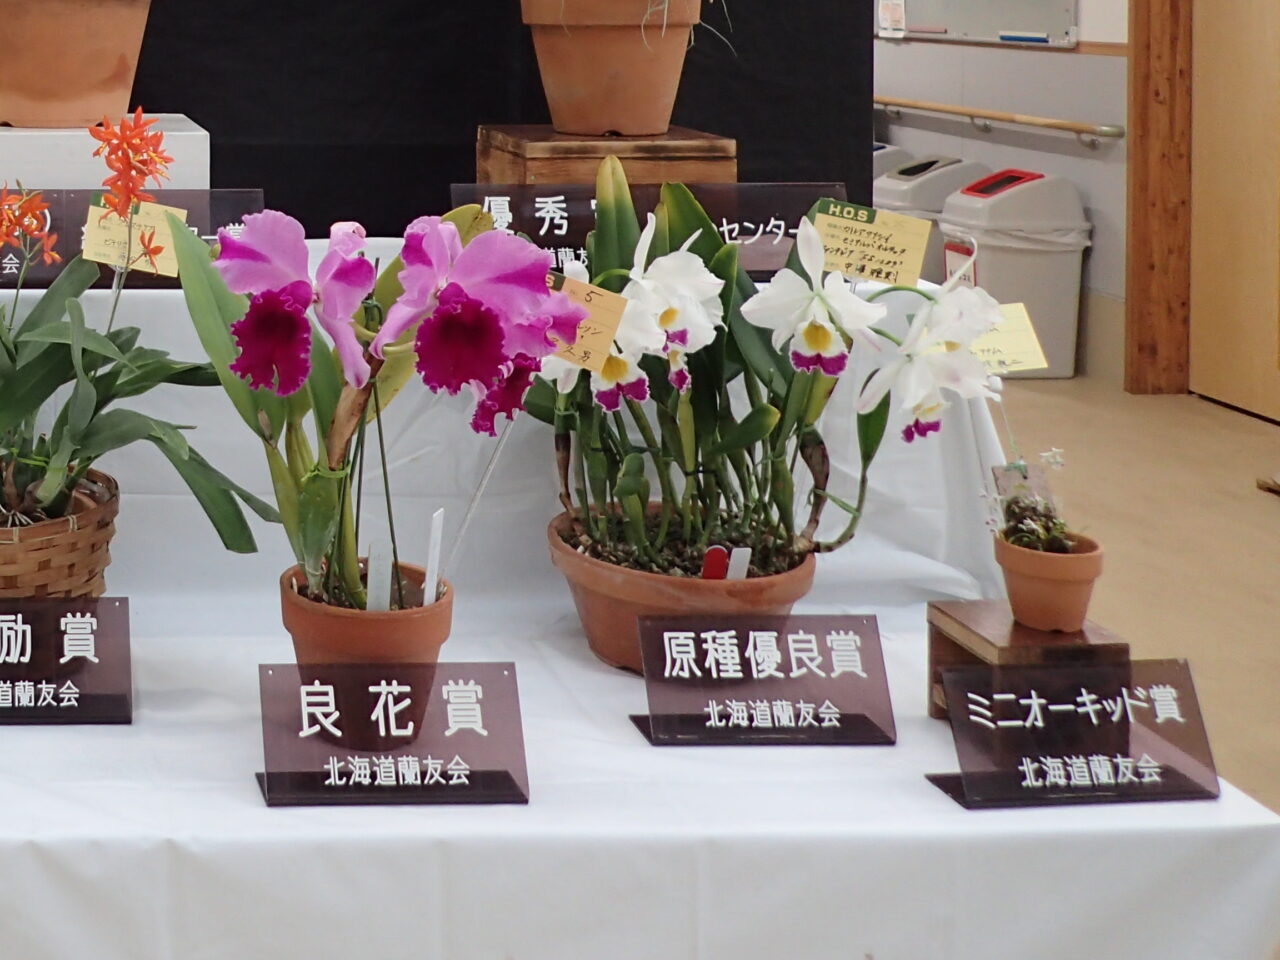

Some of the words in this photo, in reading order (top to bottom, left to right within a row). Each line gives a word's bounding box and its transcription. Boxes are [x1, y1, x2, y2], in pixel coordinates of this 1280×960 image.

[828, 203, 869, 222] H.O.S
[584, 290, 604, 303] 5
[663, 630, 868, 679] 原種優良賞
[299, 679, 488, 737] 良花賞
[704, 698, 841, 728] 北海道蘭友会
[967, 684, 1185, 729] ミニオーキッド賞
[324, 754, 470, 785] 北海道蘭友会
[1018, 753, 1162, 788] 北海道蘭友会
